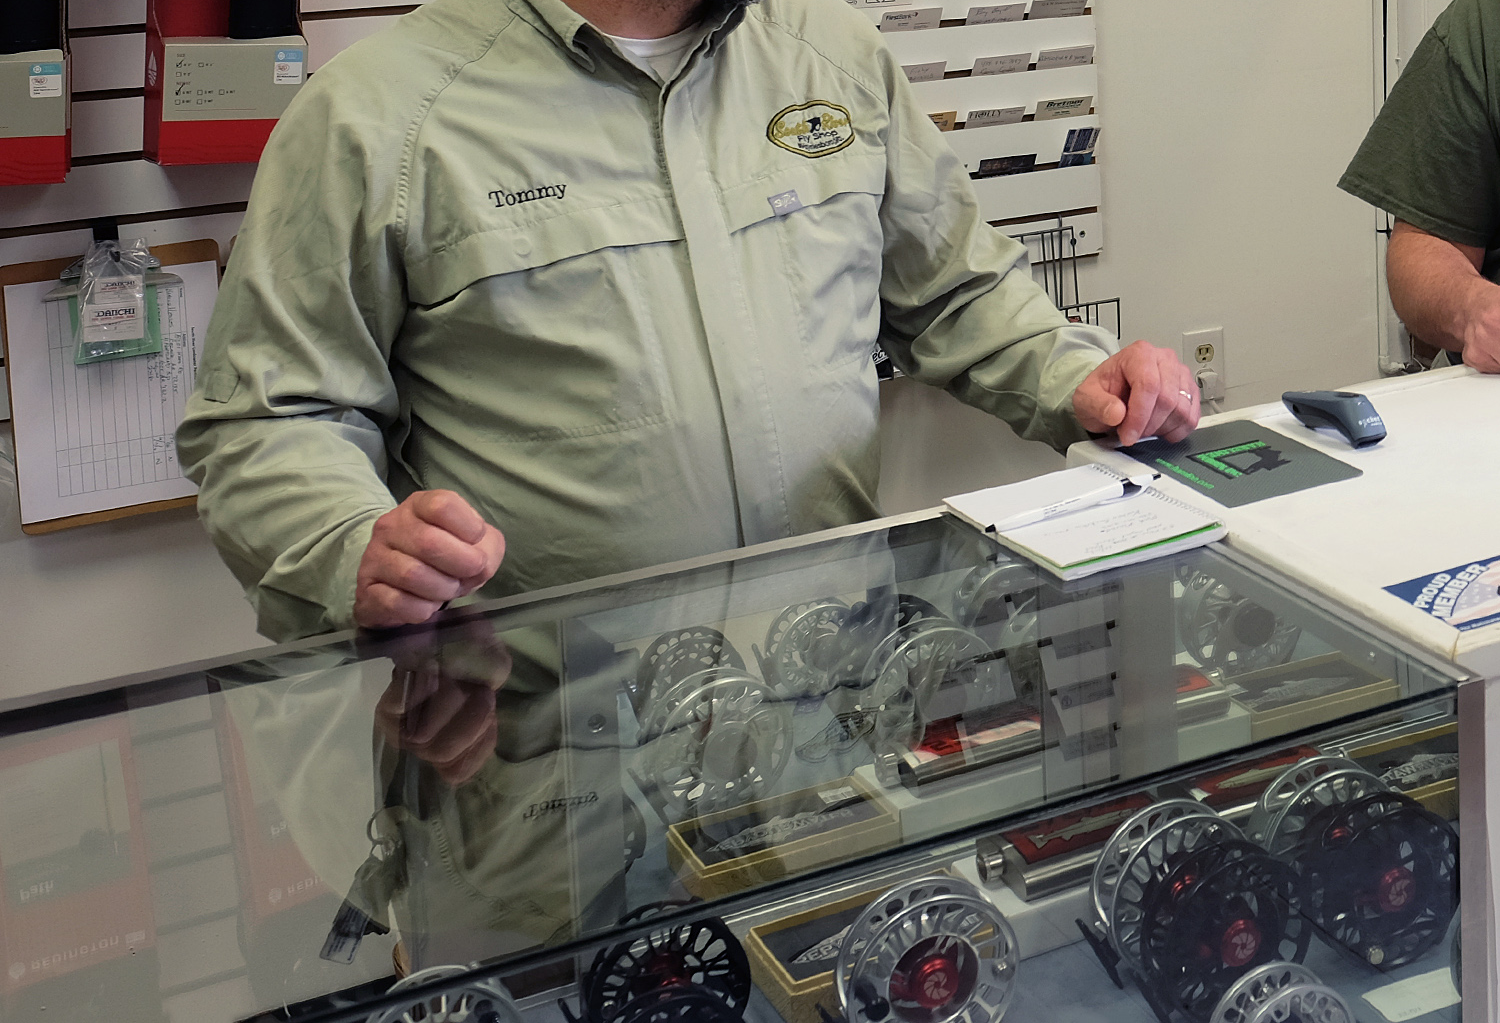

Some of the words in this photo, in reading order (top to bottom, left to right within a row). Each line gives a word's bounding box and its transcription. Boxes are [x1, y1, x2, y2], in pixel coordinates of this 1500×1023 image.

[488, 184, 567, 208] Tommy
[1413, 572, 1452, 609] PROUD
[1431, 563, 1490, 617] MEMBER
